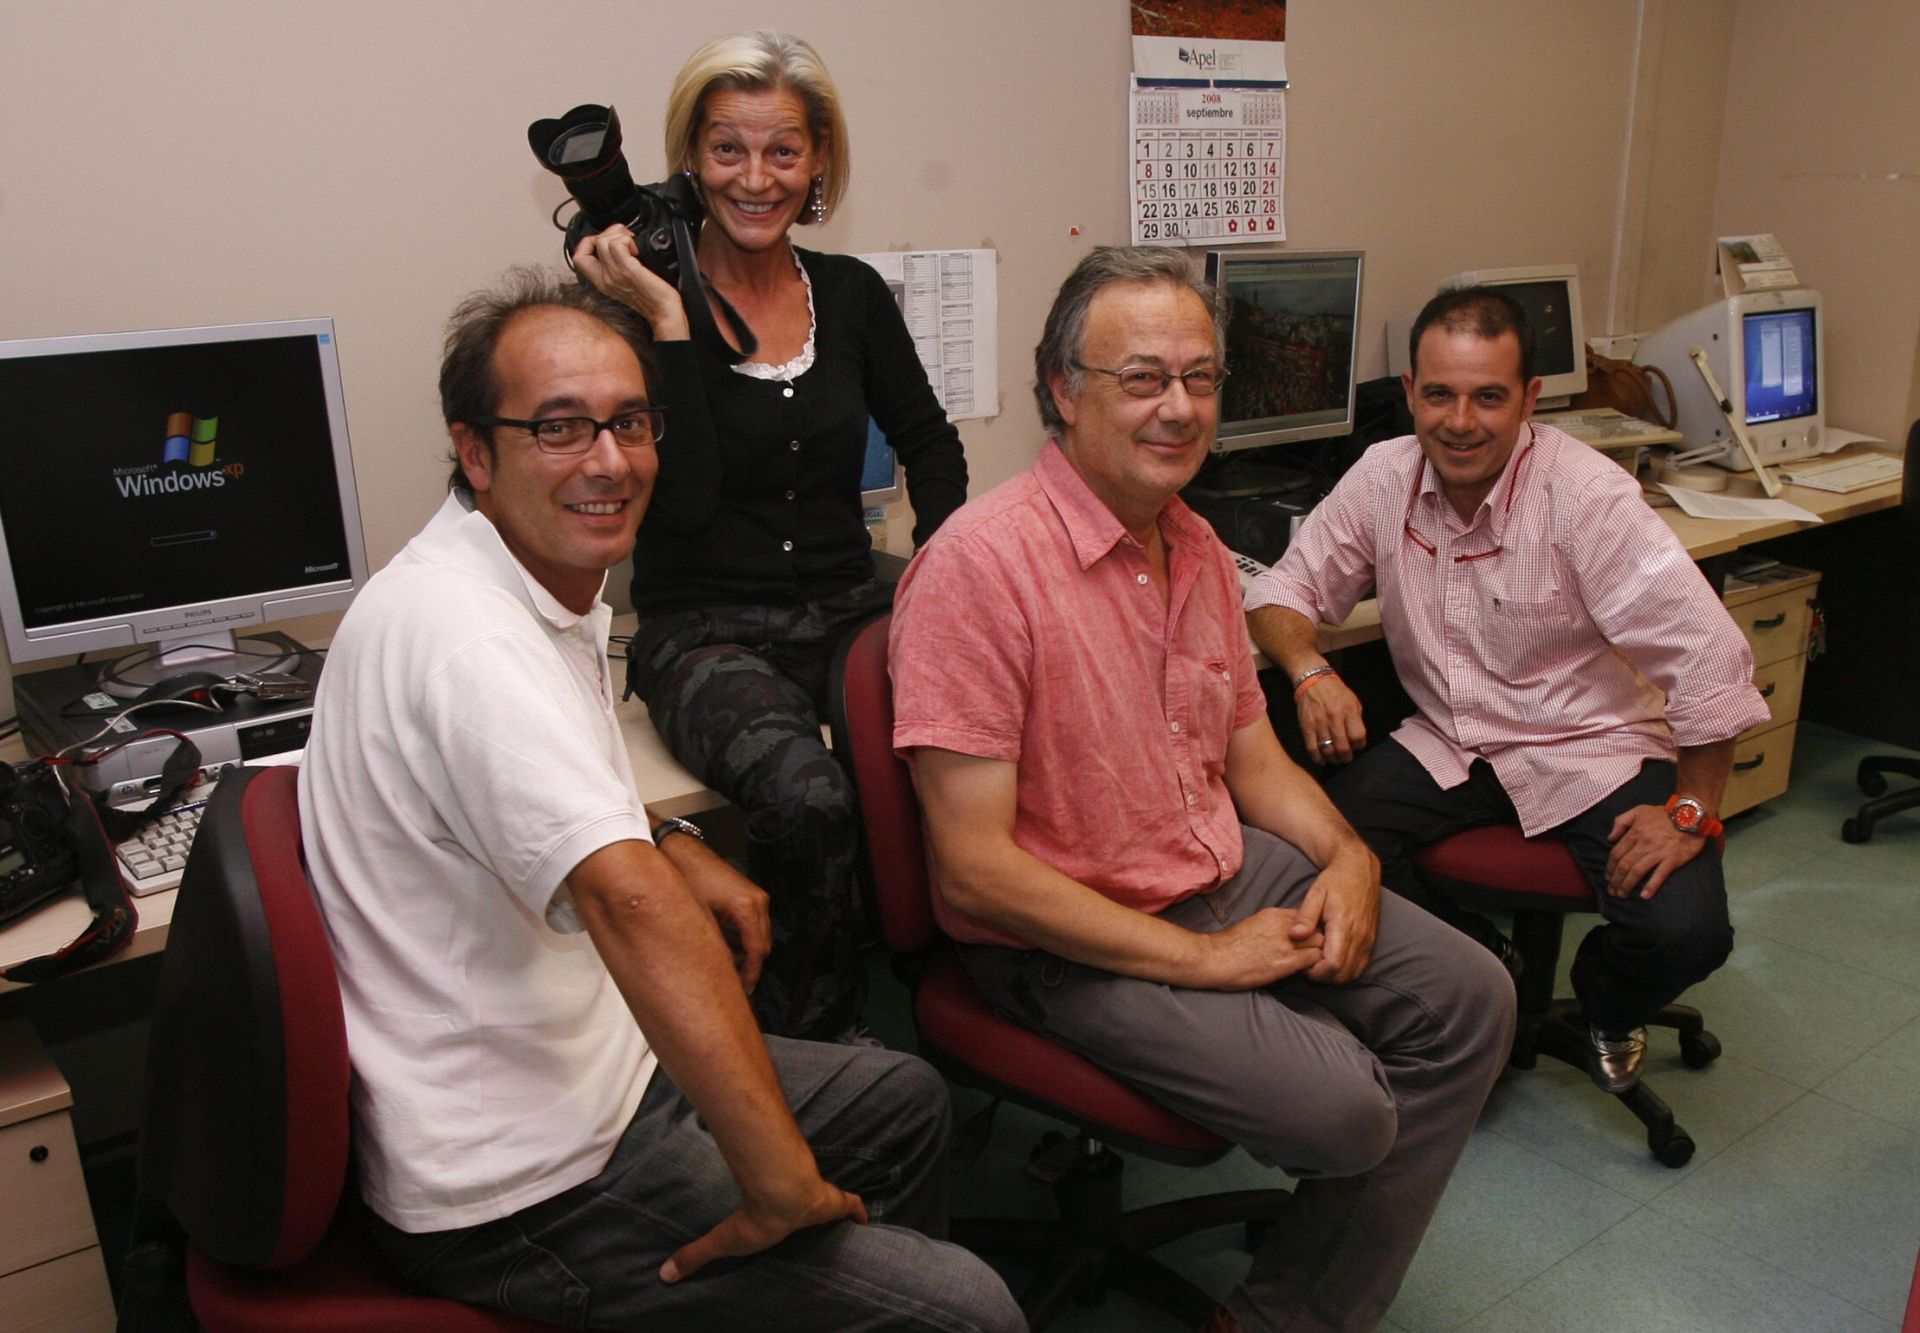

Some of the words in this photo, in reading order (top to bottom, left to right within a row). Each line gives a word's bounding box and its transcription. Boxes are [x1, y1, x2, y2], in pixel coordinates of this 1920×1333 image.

[1189, 49, 1216, 70] Apel
[1202, 94, 1221, 104] 2008
[1186, 107, 1233, 120] septiembre
[1144, 143, 1150, 157] 1
[1165, 143, 1172, 157] 2
[1187, 143, 1193, 157] 3
[1207, 143, 1214, 156] 4
[1227, 143, 1233, 156] 5
[1247, 143, 1253, 156] 6
[1268, 143, 1273, 156] 7
[1145, 164, 1152, 178] 8
[1165, 164, 1172, 177] 9
[1184, 164, 1197, 177] 10
[1204, 164, 1216, 177] 11
[1224, 163, 1237, 176] 12
[1243, 162, 1256, 175] 13
[1264, 162, 1276, 175] 14
[1143, 184, 1156, 198] 15
[1162, 184, 1176, 197] 16
[1184, 184, 1196, 197] 17
[1204, 183, 1217, 196] 18
[1224, 182, 1236, 195] 19
[1243, 181, 1256, 194] 20
[1263, 181, 1274, 194] 21
[1143, 204, 1157, 217] 22
[1163, 204, 1177, 217] 23
[1185, 203, 1198, 216] 24
[1204, 202, 1218, 216] 25
[1226, 201, 1239, 214] 26
[1245, 200, 1256, 213] 27
[1263, 200, 1275, 213] 28
[1144, 224, 1158, 238] 29
[1165, 223, 1178, 236] 30
[116, 470, 225, 498] Windows
[225, 464, 244, 479] xp
[305, 563, 338, 573] Microsoft
